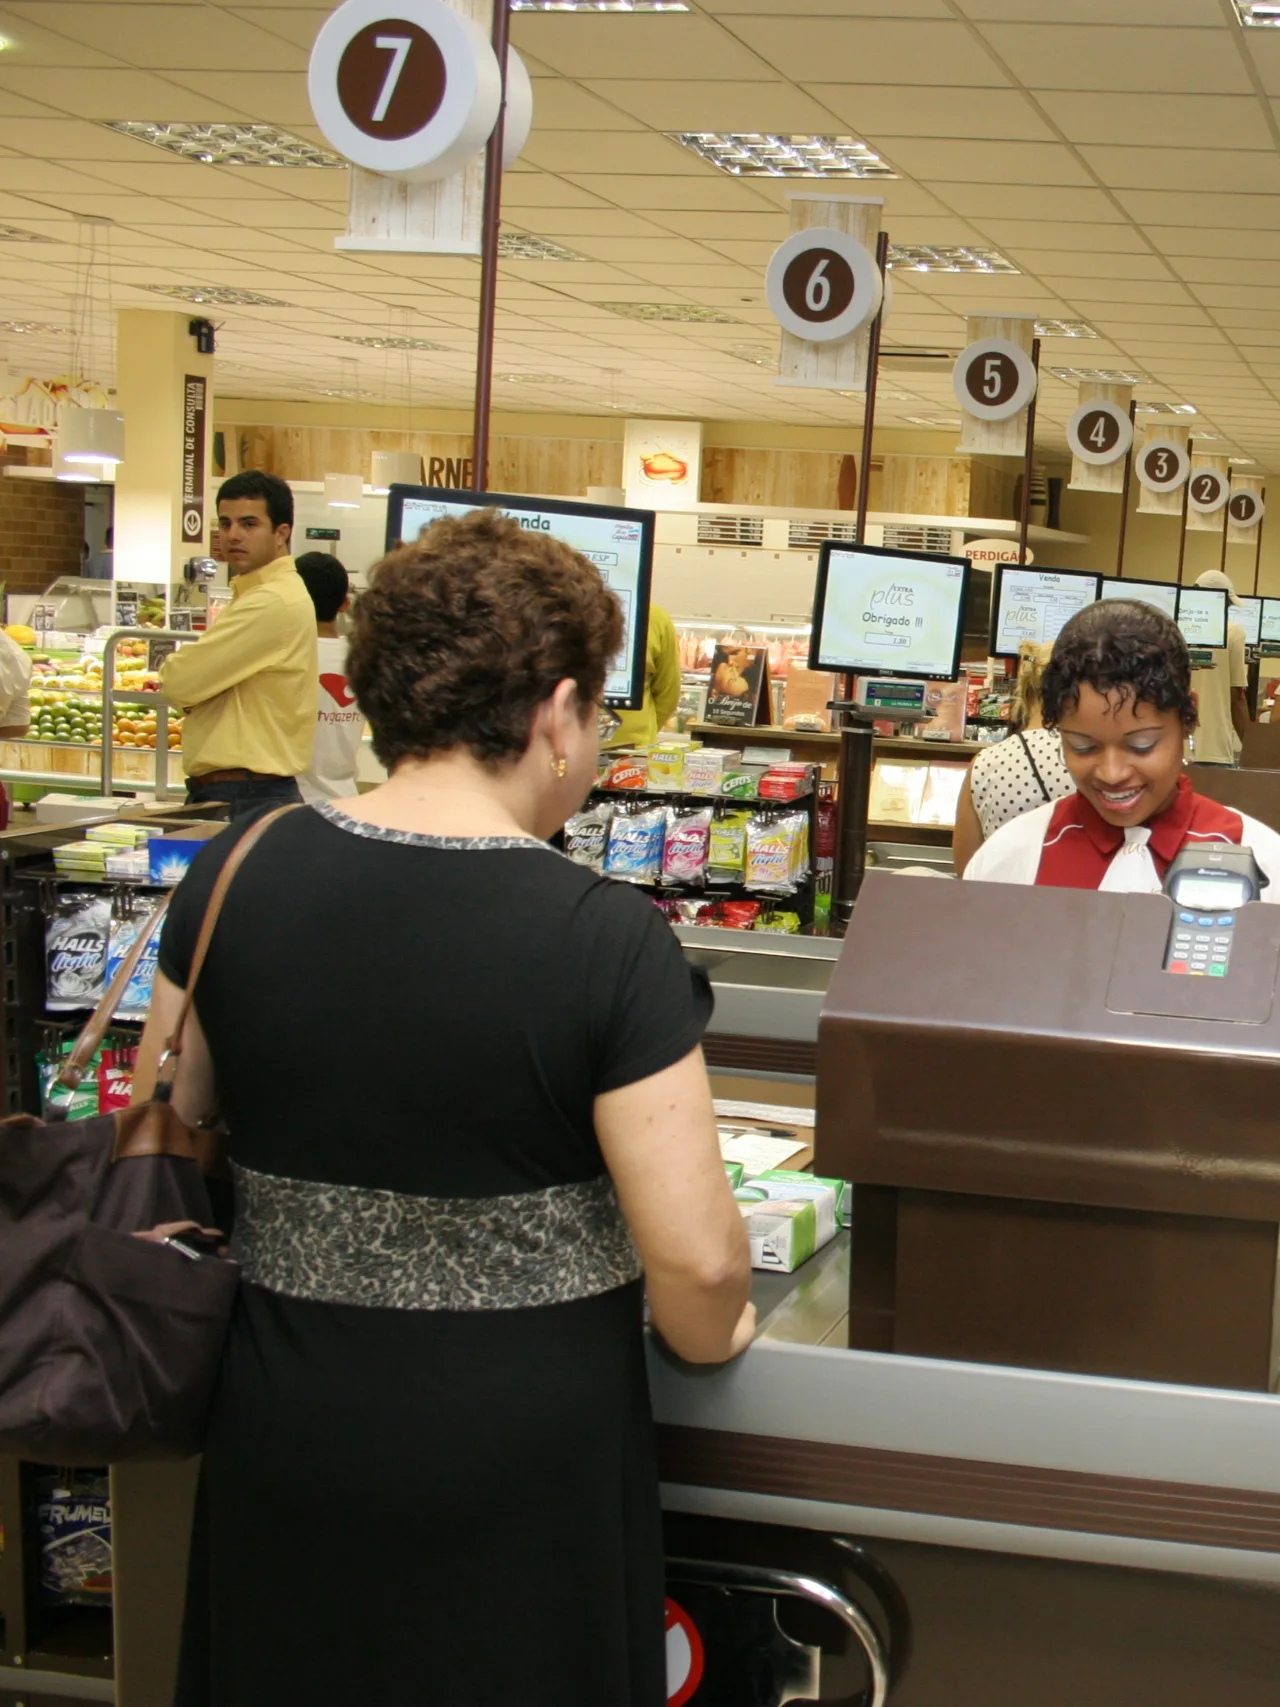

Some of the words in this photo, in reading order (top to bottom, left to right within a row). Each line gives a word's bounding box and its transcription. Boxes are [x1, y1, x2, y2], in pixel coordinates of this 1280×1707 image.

[374, 36, 413, 122] 7
[805, 259, 831, 312] 6
[983, 359, 1002, 399] 5
[186, 382, 197, 434] CONSULTA
[1089, 417, 1106, 448] 4
[184, 437, 195, 450] DE
[420, 456, 489, 490] RNE
[1154, 452, 1169, 478] 3
[184, 453, 195, 505] TERMINAL
[1199, 478, 1212, 501] 2
[1240, 498, 1246, 518] 1
[965, 549, 1027, 562] PERDIGÃ
[1039, 574, 1060, 583] Venda
[870, 583, 915, 610] plus
[862, 612, 910, 627] Obrigado
[1005, 604, 1038, 626] plus
[651, 753, 679, 761] HALLS
[612, 767, 641, 785] CERTS
[722, 776, 751, 793] CERTS
[613, 831, 650, 843] HALLS
[750, 843, 791, 854] HALLS
[52, 936, 105, 952] HALLS
[52, 951, 101, 972] light
[39, 1504, 111, 1525] FRUMEL
